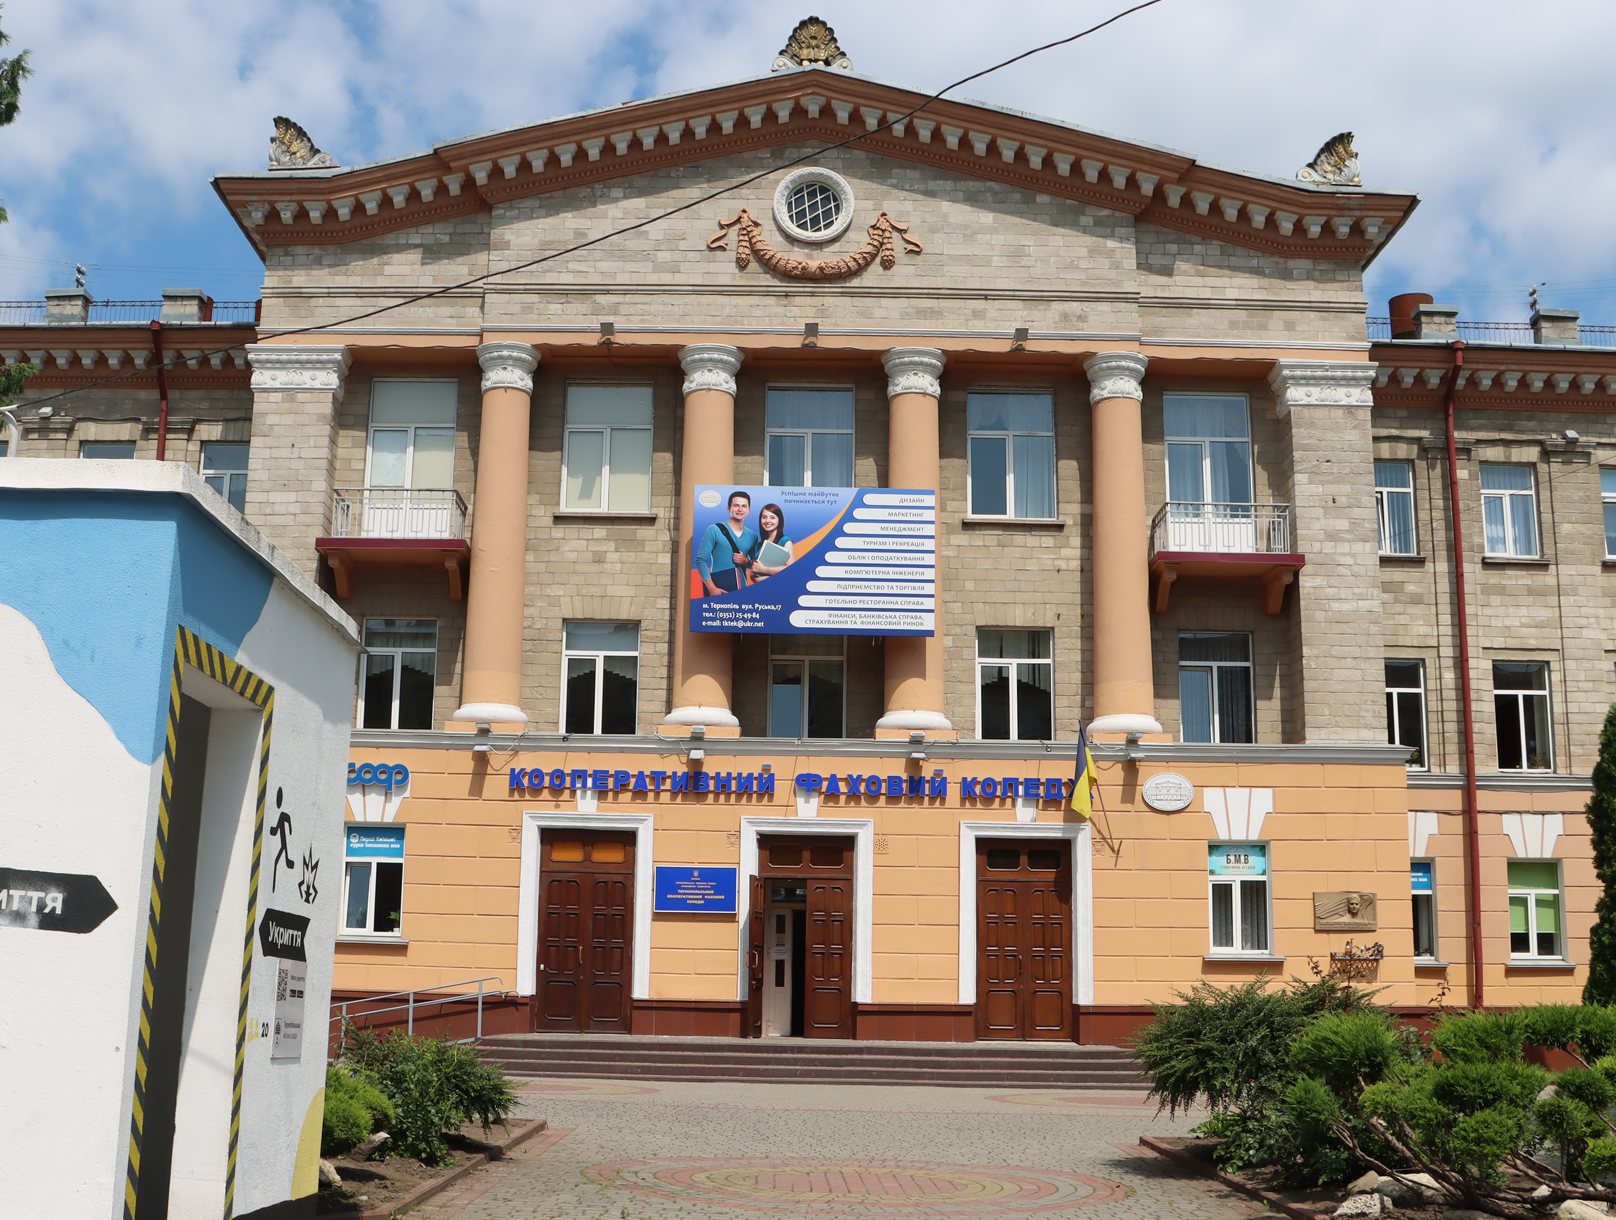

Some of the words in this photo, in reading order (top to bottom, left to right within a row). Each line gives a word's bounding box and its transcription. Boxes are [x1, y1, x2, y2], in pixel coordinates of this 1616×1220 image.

[780, 490, 806, 498] Успішне
[808, 491, 839, 499] майбутнє
[880, 525, 925, 533] МЕНЕДЖМЕНТ
[892, 540, 925, 548] РЕКРЕАЦІЯ
[710, 602, 740, 610] Тернопіль
[717, 611, 735, 619] (0352)
[722, 620, 764, 628] tktek@ukr.net
[509, 764, 776, 794] КООПЕРАТИВНИЙ
[794, 769, 948, 798] ФАХОВИЙ
[268, 920, 302, 950] Укриття
[261, 1022, 269, 1038] 20
